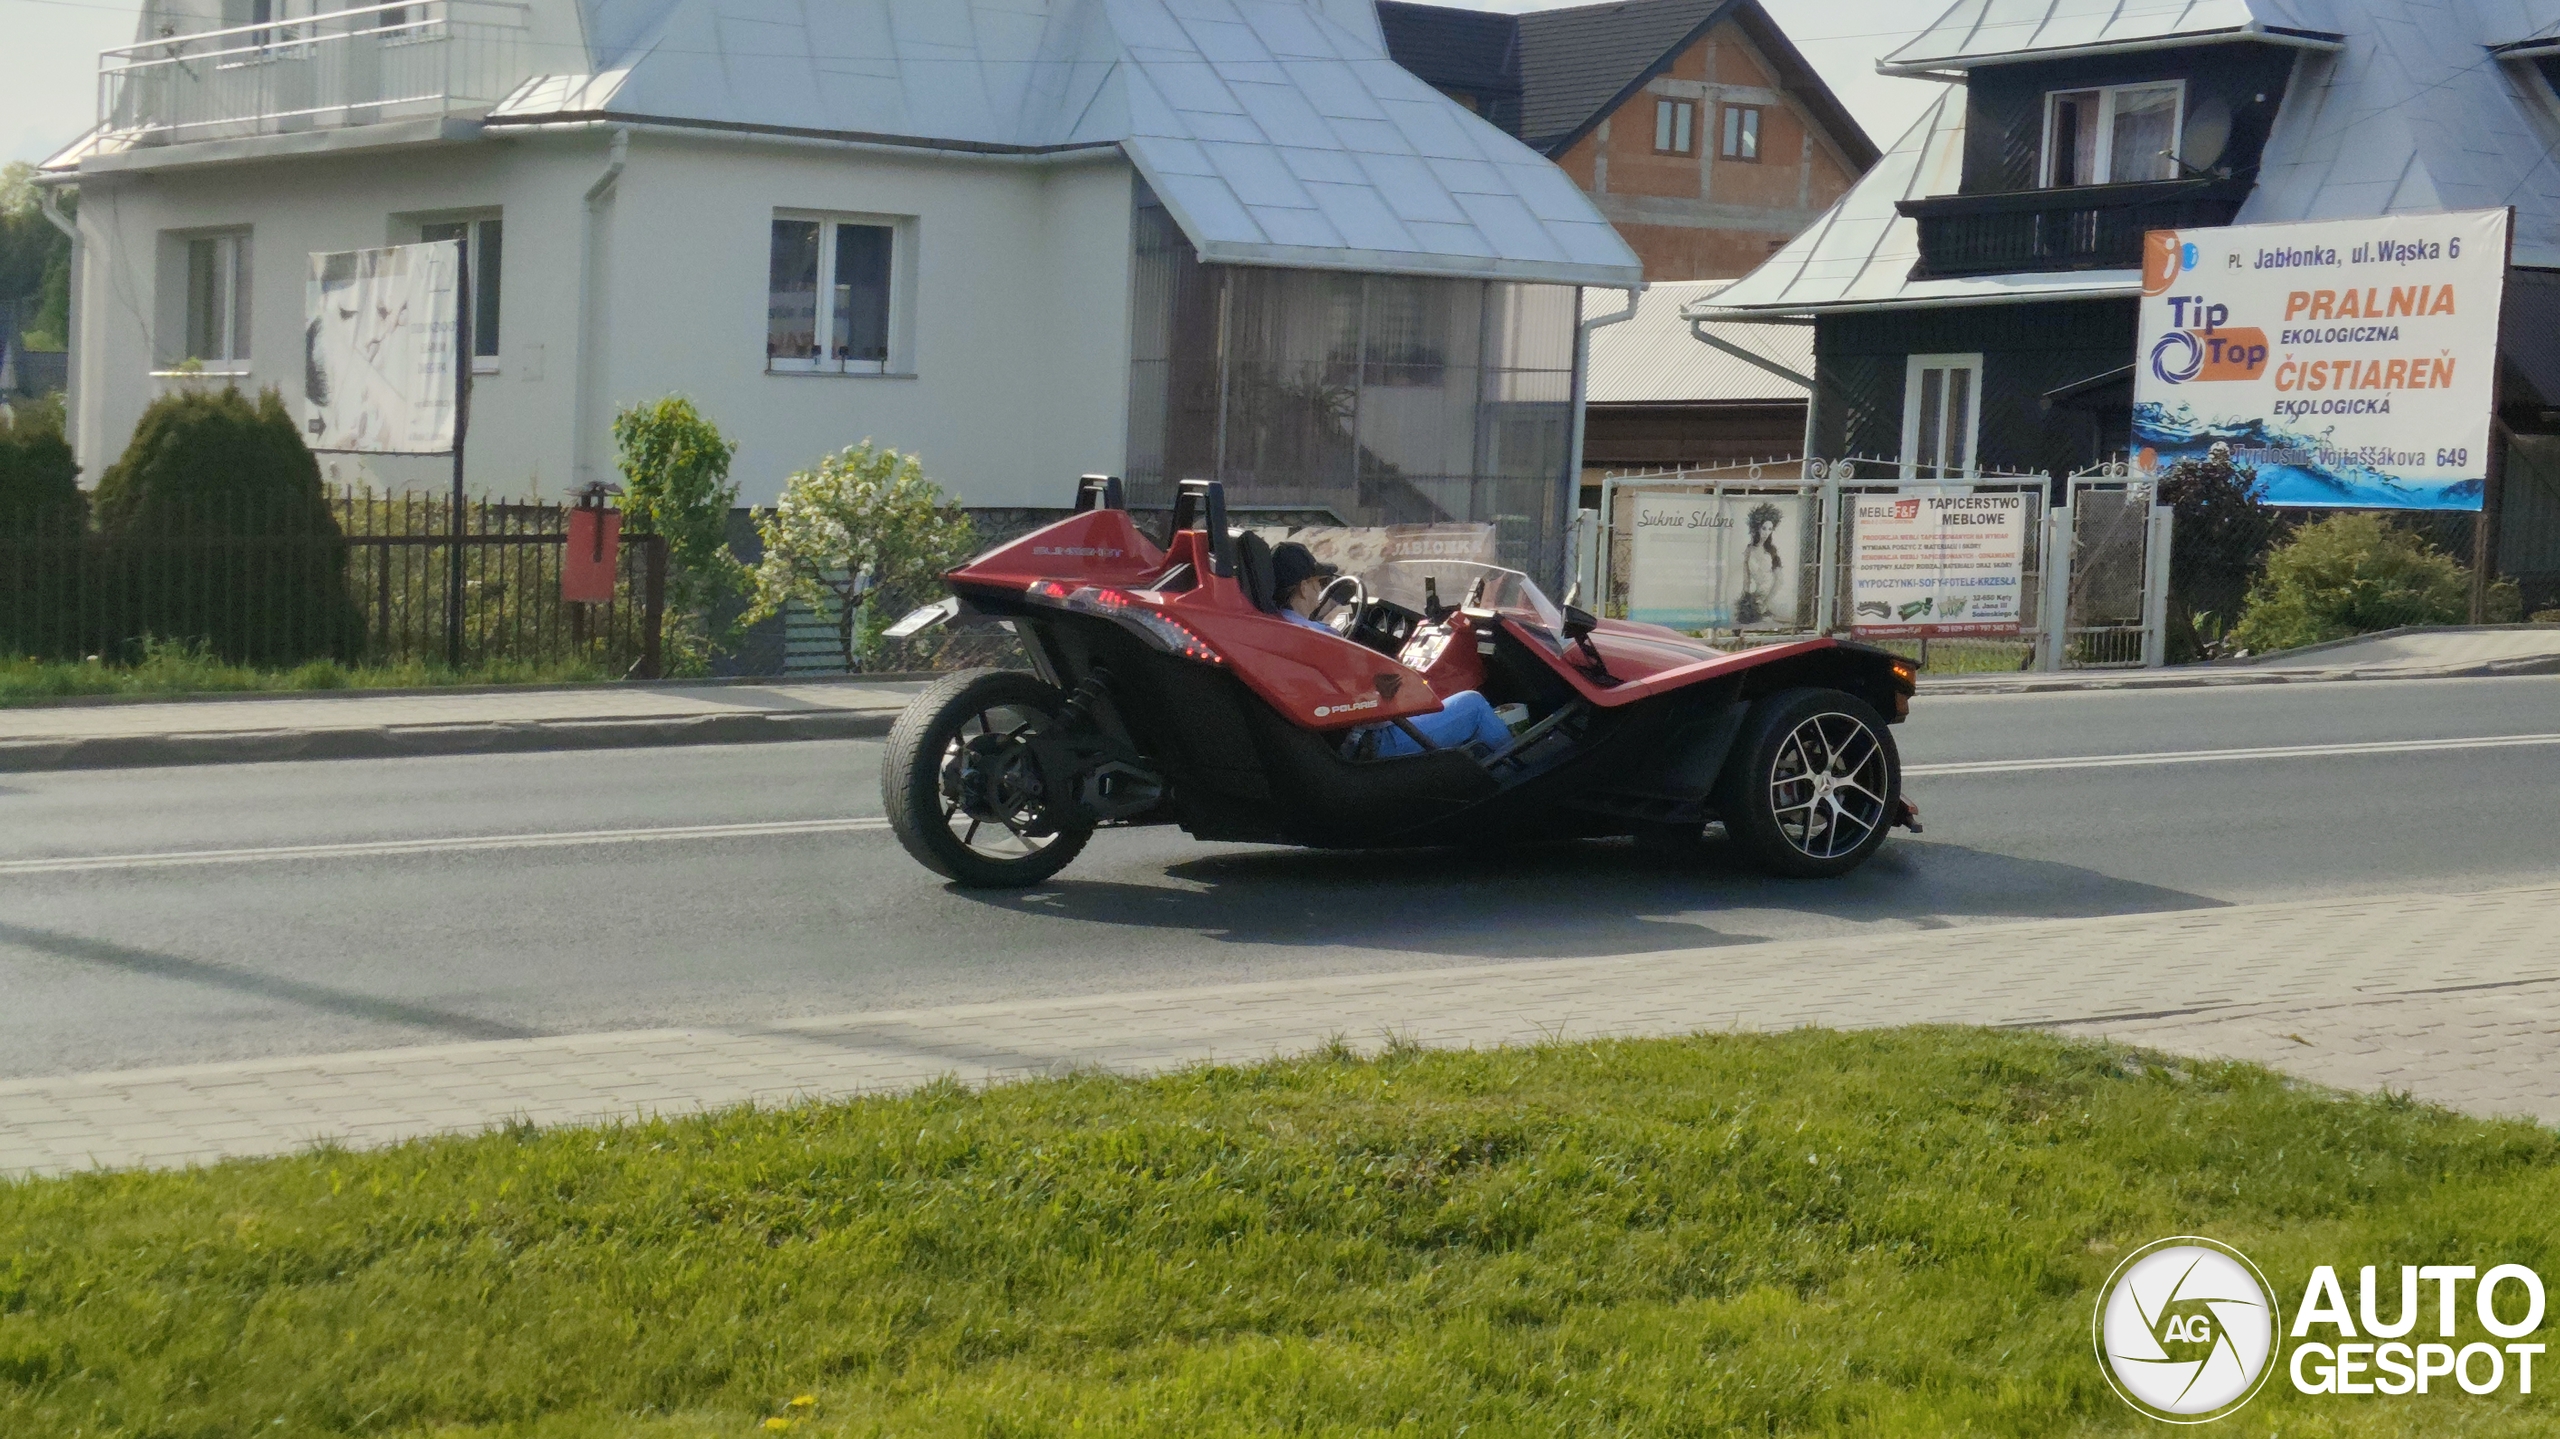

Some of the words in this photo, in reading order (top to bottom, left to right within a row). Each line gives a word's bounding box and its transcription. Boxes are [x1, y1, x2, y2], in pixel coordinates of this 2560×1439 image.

[2228, 253, 2243, 268] PL
[2253, 244, 2342, 269] Jabłonka,
[2448, 236, 2461, 259] 6
[2284, 284, 2456, 321] PRALNIA
[2167, 295, 2229, 335] Tip
[2280, 326, 2400, 344] EKOLOGICZNA
[2206, 338, 2267, 370] Top
[2275, 349, 2456, 392] ČISTIAREŇ
[2273, 392, 2391, 415] EKOLOGICKÁ
[2436, 447, 2468, 467] 649
[1859, 507, 1894, 518] MEBLE
[1895, 505, 1917, 518] F&F
[1928, 497, 2019, 509] TAPICERSTWO
[1637, 509, 1684, 527] Suknie
[1942, 513, 2005, 525] MEBLOWE
[1332, 700, 1378, 713] POLARIS
